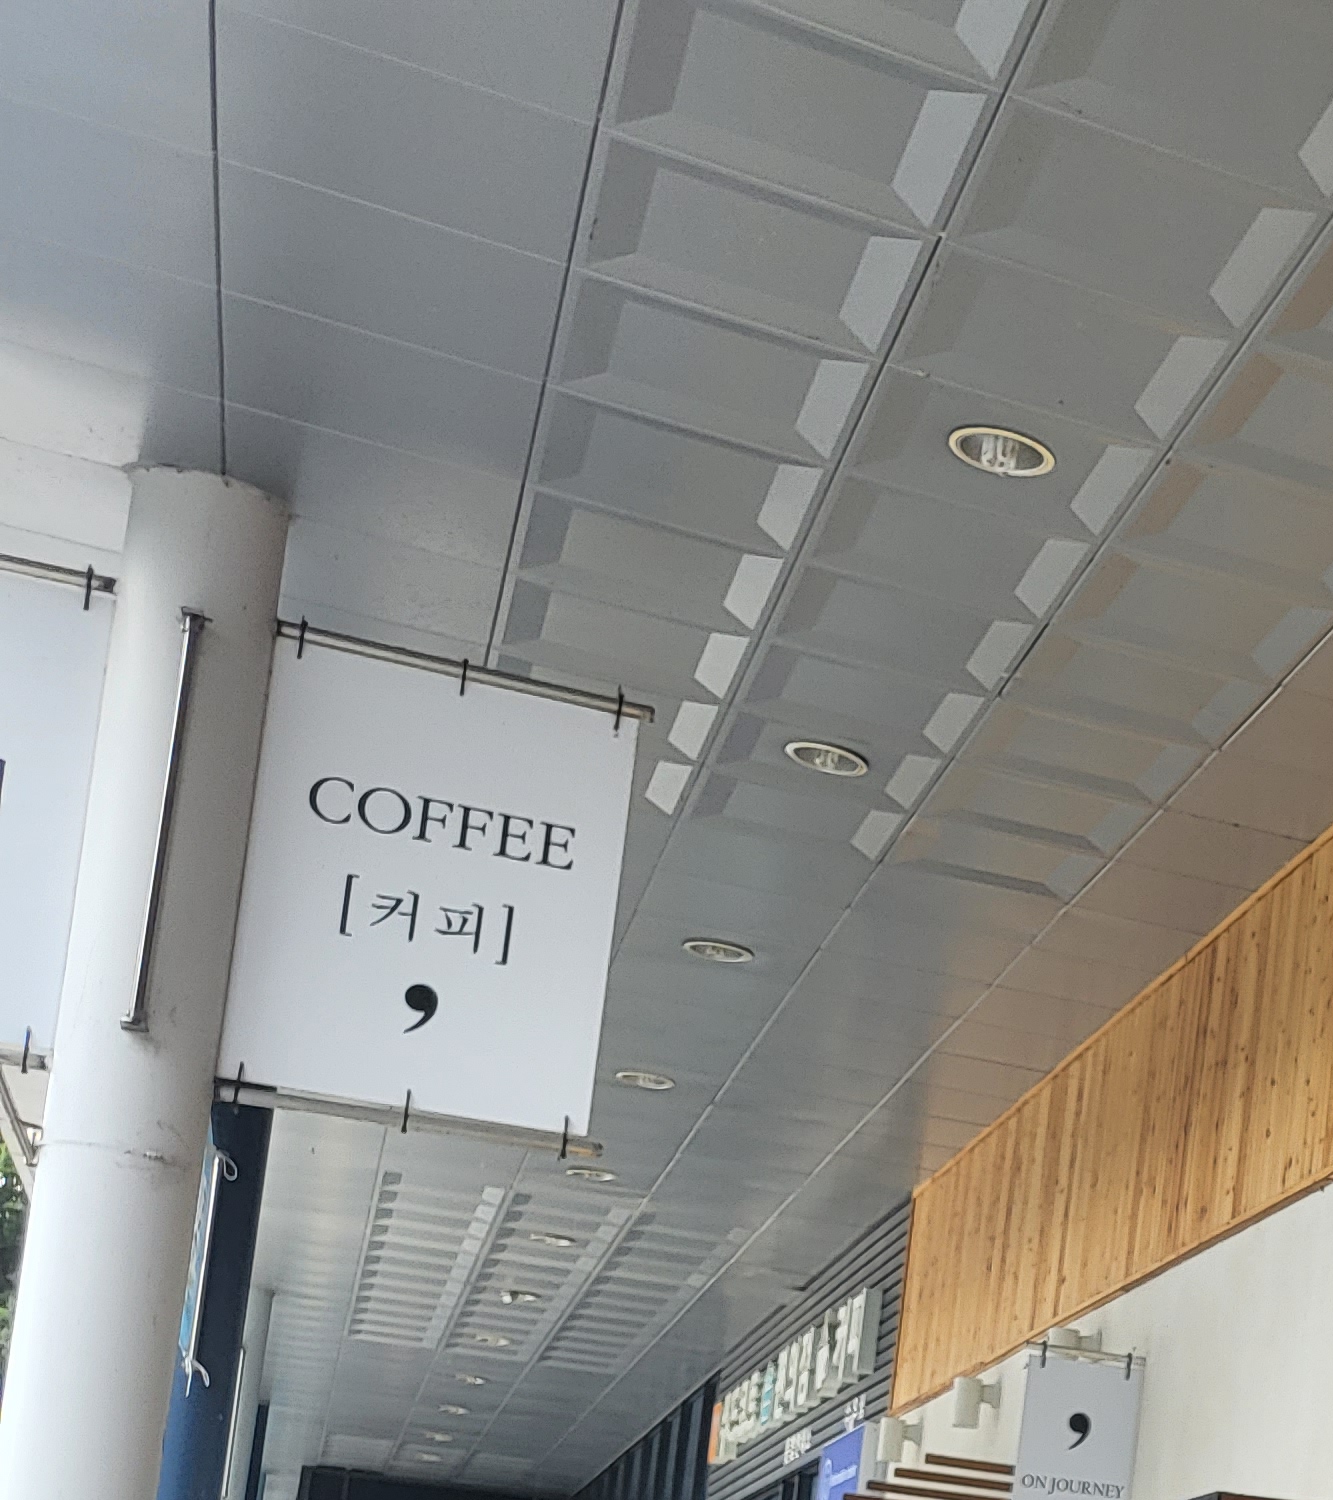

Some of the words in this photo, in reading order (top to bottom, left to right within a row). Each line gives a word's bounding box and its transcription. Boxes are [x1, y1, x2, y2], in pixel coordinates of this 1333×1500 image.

[309, 776, 576, 870] COFFEE
[1022, 1474, 1047, 1489] ON
[1048, 1477, 1125, 1499] JOURNEY
